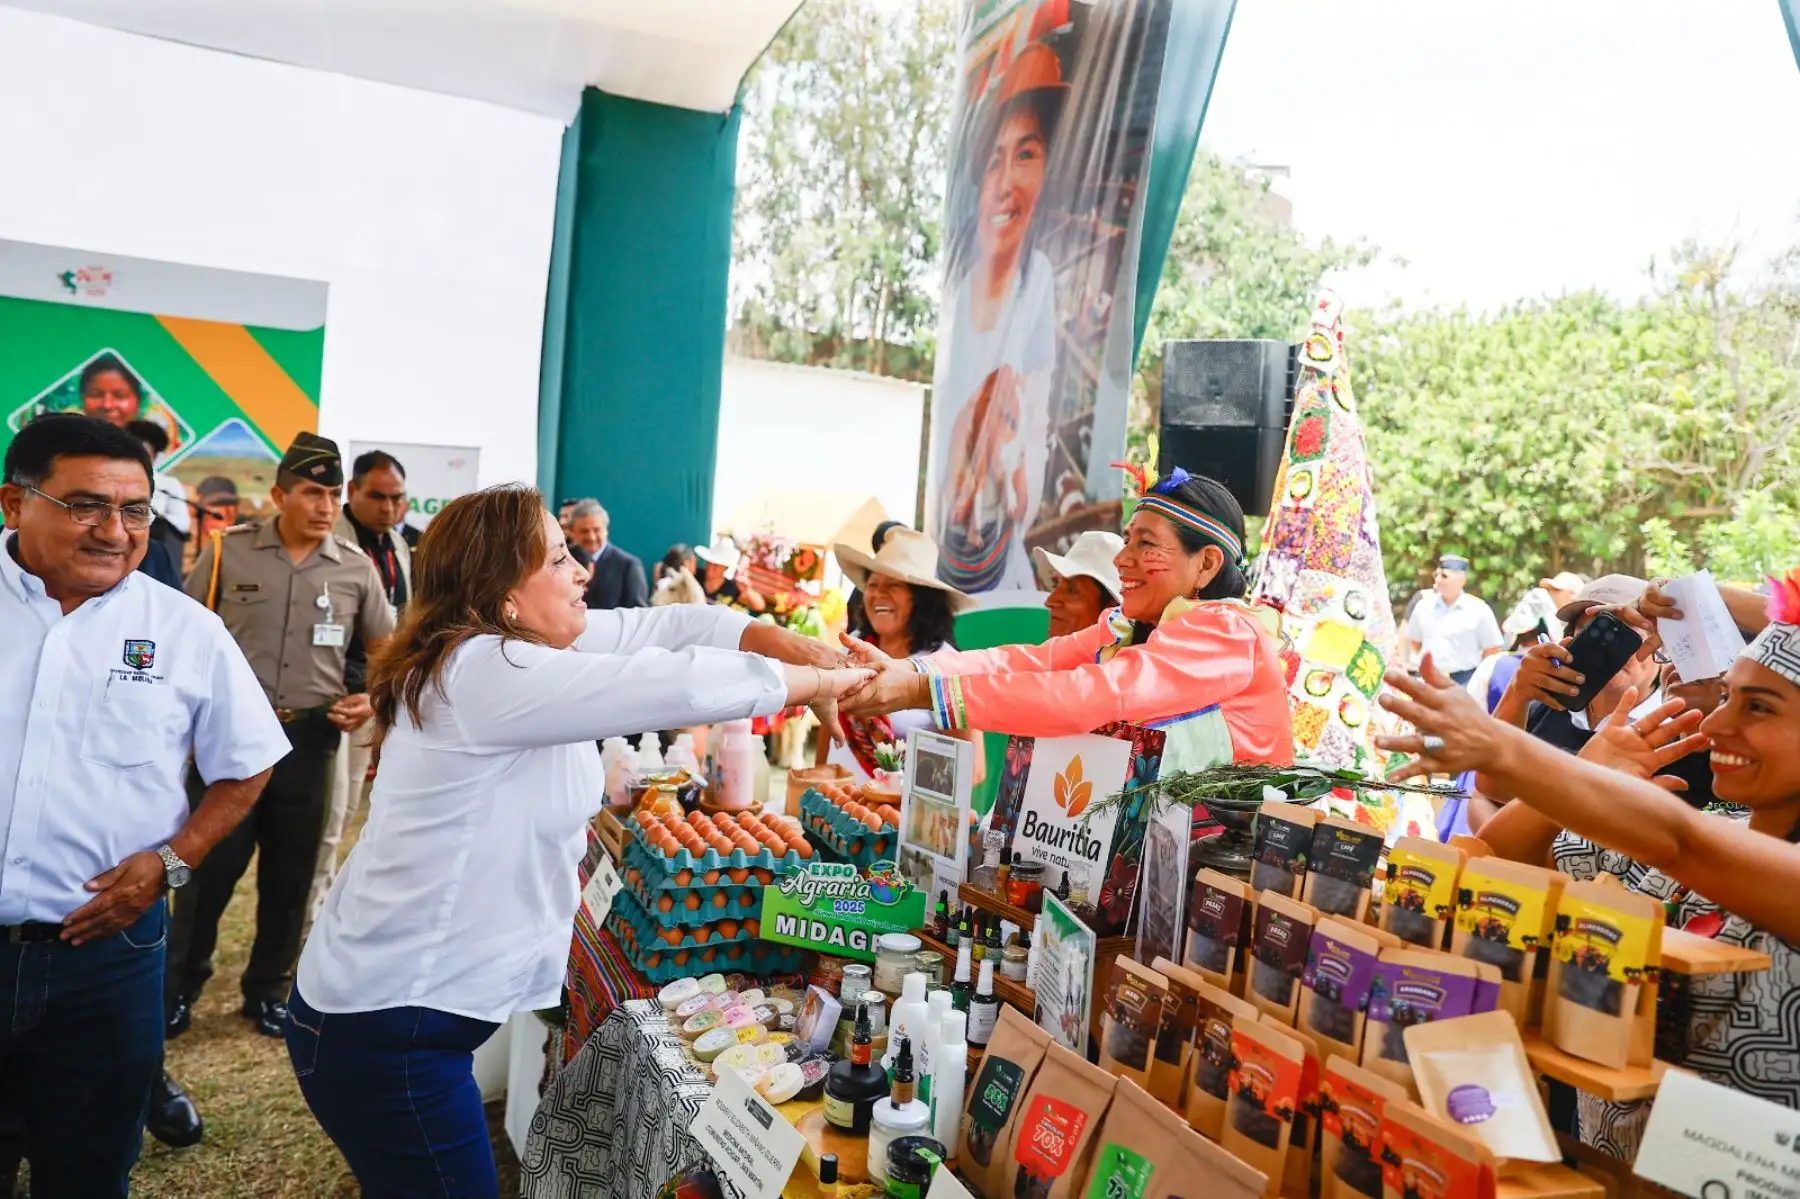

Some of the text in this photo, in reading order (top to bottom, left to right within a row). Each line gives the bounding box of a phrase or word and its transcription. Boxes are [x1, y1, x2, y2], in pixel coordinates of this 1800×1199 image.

[1022, 810, 1102, 862] Bauritia
[1032, 845, 1048, 860] vive
[810, 863, 854, 878] EXPO
[780, 870, 871, 906] Agraria
[834, 900, 865, 913] 2025
[1033, 1123, 1065, 1158] 70%
